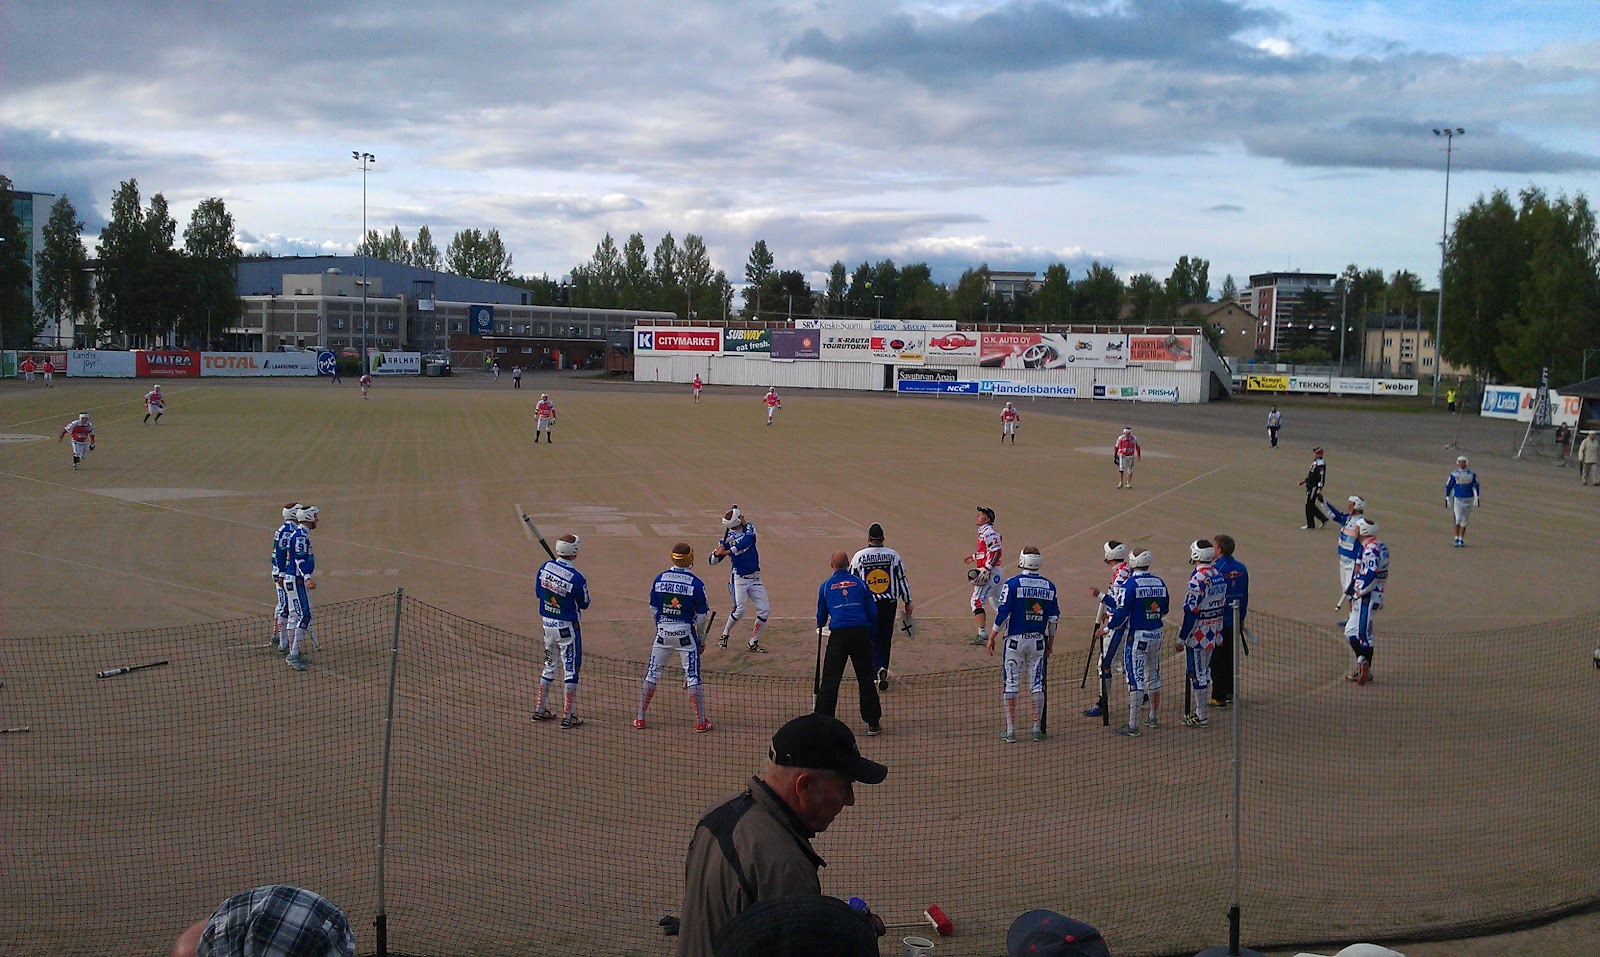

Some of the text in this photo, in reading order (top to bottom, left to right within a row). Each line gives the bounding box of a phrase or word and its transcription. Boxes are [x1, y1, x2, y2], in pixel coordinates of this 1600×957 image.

[726, 329, 765, 340] SUBWAY
[983, 336, 1031, 344] O.K. AUTO OY
[639, 334, 652, 347] K
[658, 336, 716, 347] CITYMARKET
[736, 343, 748, 352] eat
[146, 355, 192, 366] VALTRA
[204, 356, 257, 369] TOTAL
[993, 384, 1076, 395] Handelsbanken
[1299, 381, 1330, 389] TEKNOS
[1385, 382, 1414, 391] weber
[660, 583, 689, 594] CARLSON
[1022, 588, 1050, 599] VATANEN
[662, 607, 682, 615] terra
